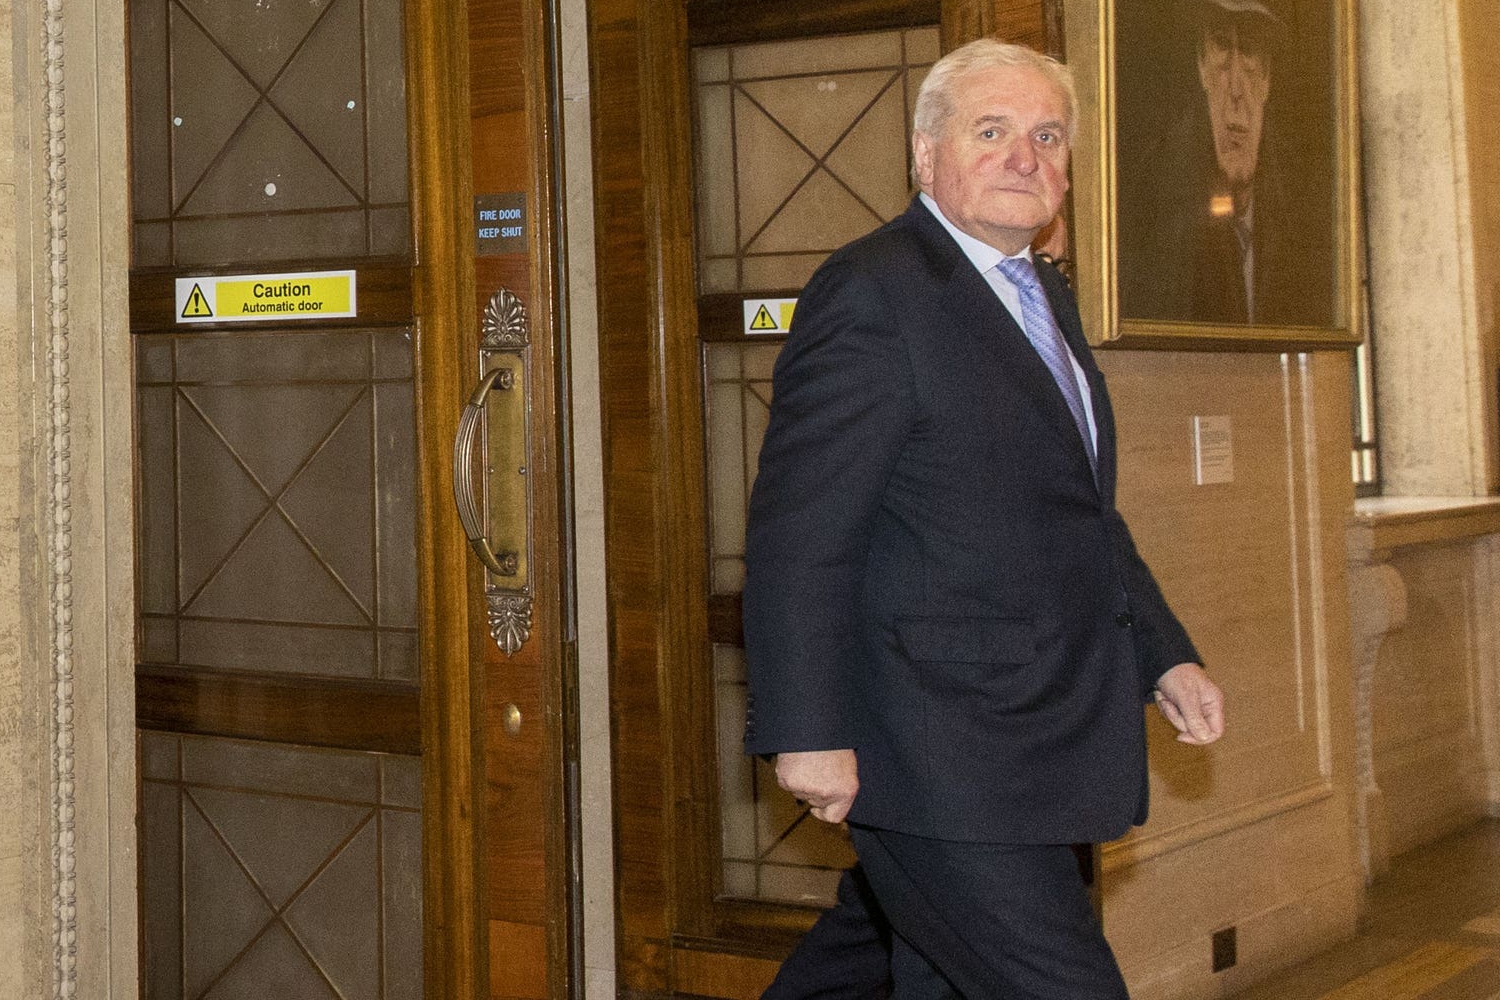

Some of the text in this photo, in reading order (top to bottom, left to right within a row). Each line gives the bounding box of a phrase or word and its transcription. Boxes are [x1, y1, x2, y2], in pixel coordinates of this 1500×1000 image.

[480, 208, 522, 220] FIRE DOOR
[479, 226, 522, 238] KEEP SHUT
[253, 282, 311, 298] Caution
[242, 300, 323, 313] Automatic door
